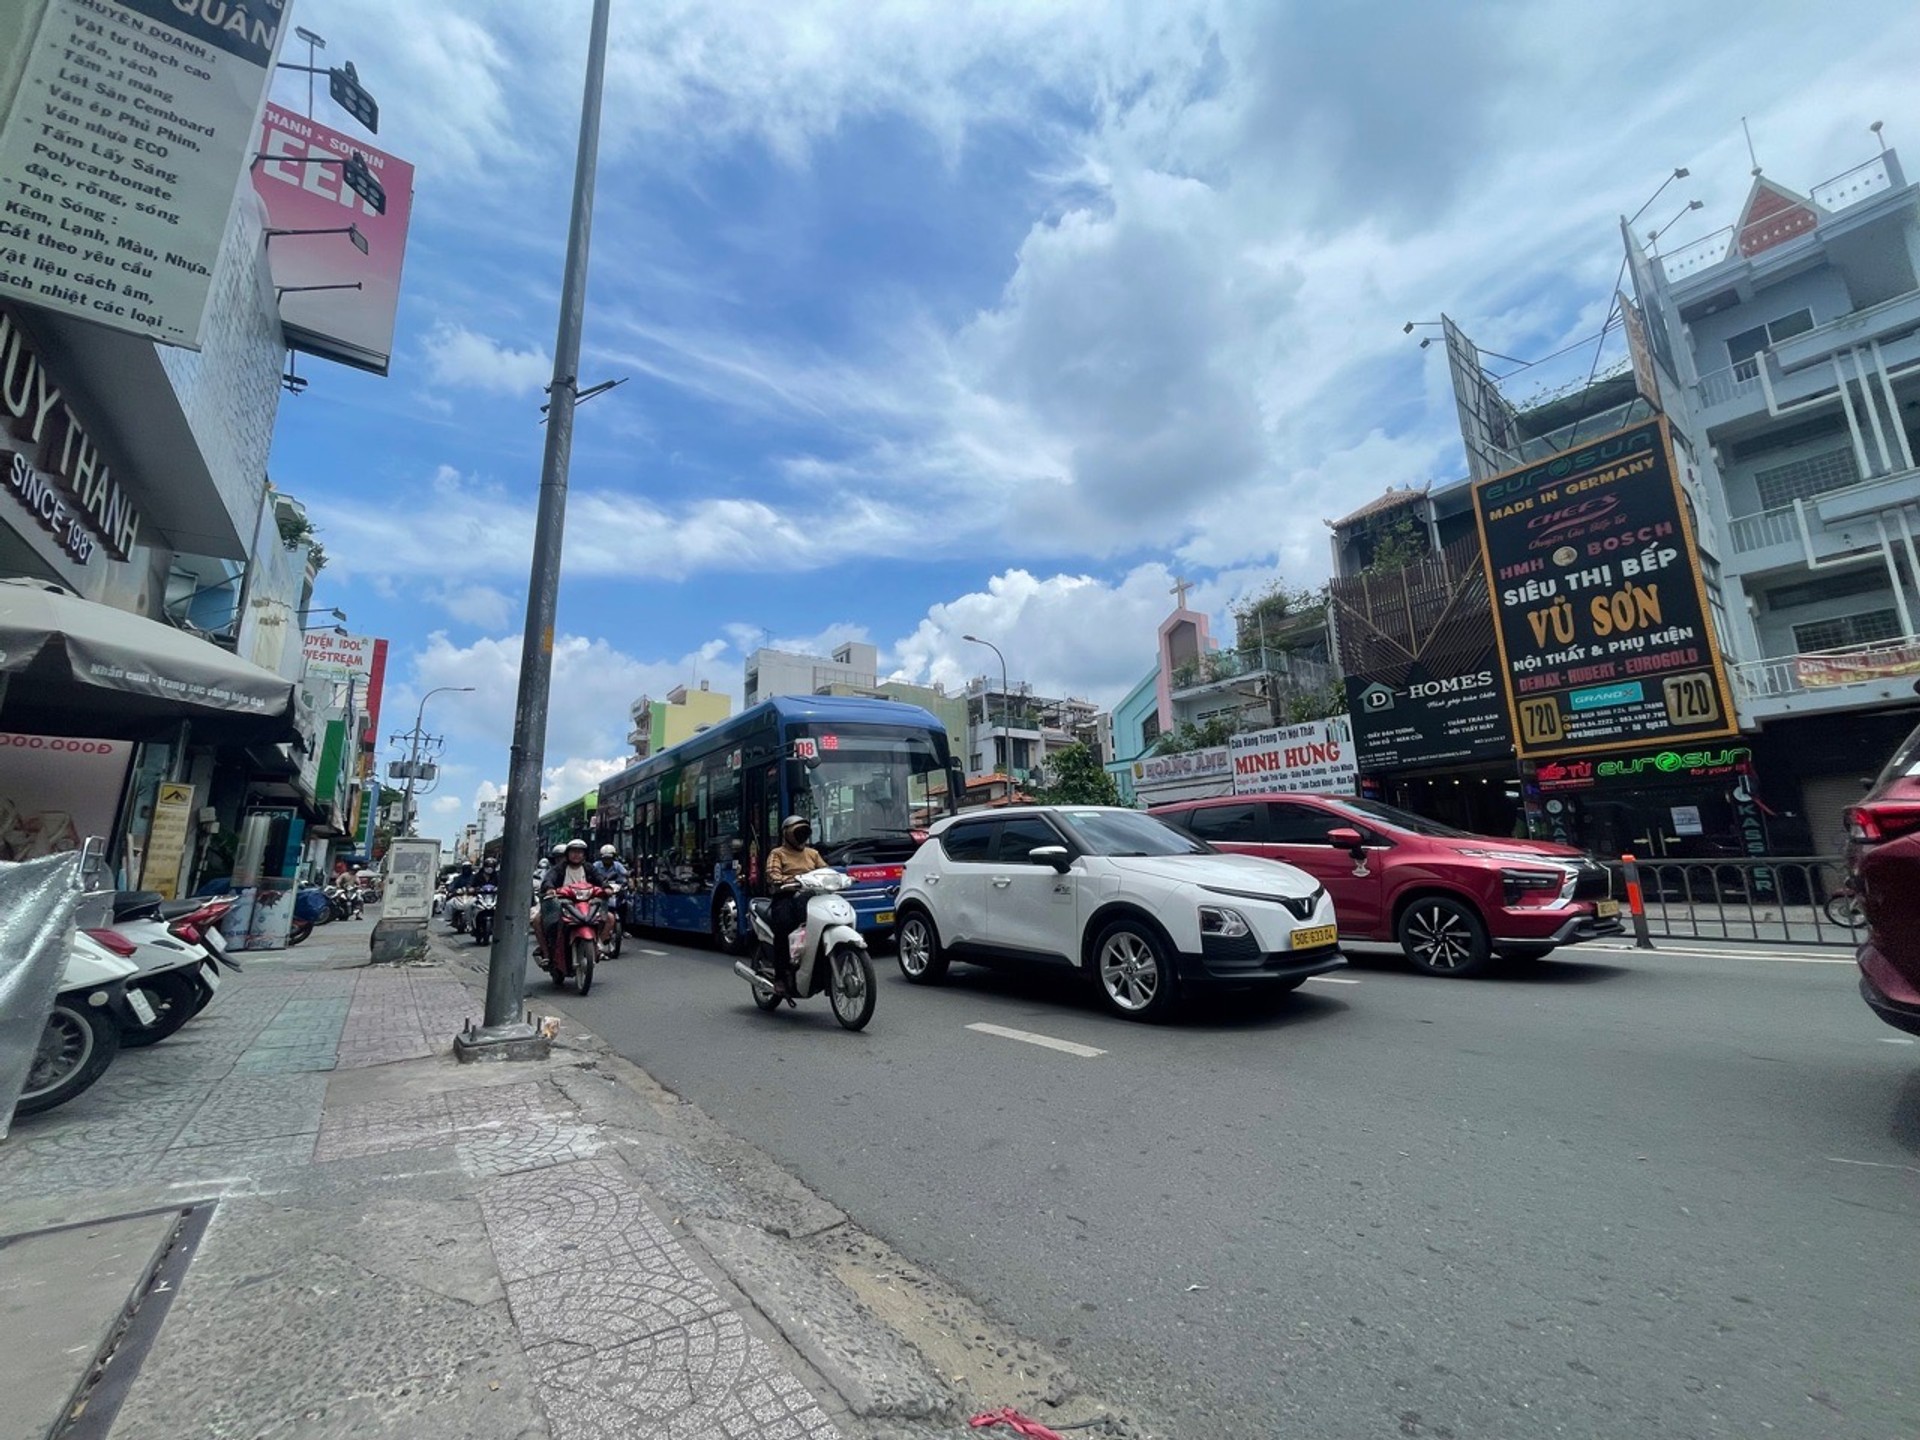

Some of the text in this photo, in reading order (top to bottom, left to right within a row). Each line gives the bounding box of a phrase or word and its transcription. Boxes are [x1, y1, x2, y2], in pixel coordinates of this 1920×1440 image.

[76, 0, 207, 58] HUYÊN DOANH
[120, 56, 158, 78] vách
[133, 41, 179, 68] thạch
[184, 64, 211, 81] cao
[45, 103, 169, 159] Ván nhựa ECO
[89, 101, 113, 117] ép
[119, 111, 150, 132] Phủ
[156, 126, 200, 153] Phim,
[133, 97, 215, 138] Cemboard
[33, 142, 172, 201] Polycarbonate
[41, 122, 178, 185] Tấm Lấy Sáng
[18, 181, 106, 223] Tôn Sóng
[25, 163, 67, 187] đặc,
[135, 201, 181, 225] sóng
[37, 233, 78, 255] theo
[82, 249, 116, 267] yêu
[60, 218, 109, 245] Lạnh,
[116, 235, 158, 261] Màu,
[33, 256, 67, 278] liệu
[73, 271, 117, 293] cách
[122, 284, 154, 305] âm,
[40, 283, 88, 306] nhiệt
[93, 300, 125, 317] các
[130, 307, 164, 328] loại
[60, 403, 140, 562] THANH
[1488, 456, 1655, 521] MADE IN GERMANY
[10, 452, 96, 566] SINCE 1987
[1587, 520, 1673, 556] BOSCH
[1500, 557, 1545, 580] HMH
[1503, 541, 1678, 607] SIÊU THỊ BẾP
[1527, 581, 1663, 649] VŨ SƠN
[339, 639, 362, 651] IDOL
[1513, 625, 1694, 673] NỘI THẤT & PHỤ KIỆN
[1625, 648, 1699, 674] EUROGOLD
[158, 676, 187, 691] Trang
[1371, 692, 1386, 706] D
[1234, 750, 1281, 776] MINH
[1284, 741, 1341, 768] HƯNG
[1597, 747, 1752, 777] eurosun
[1738, 804, 1774, 891] KASSER
